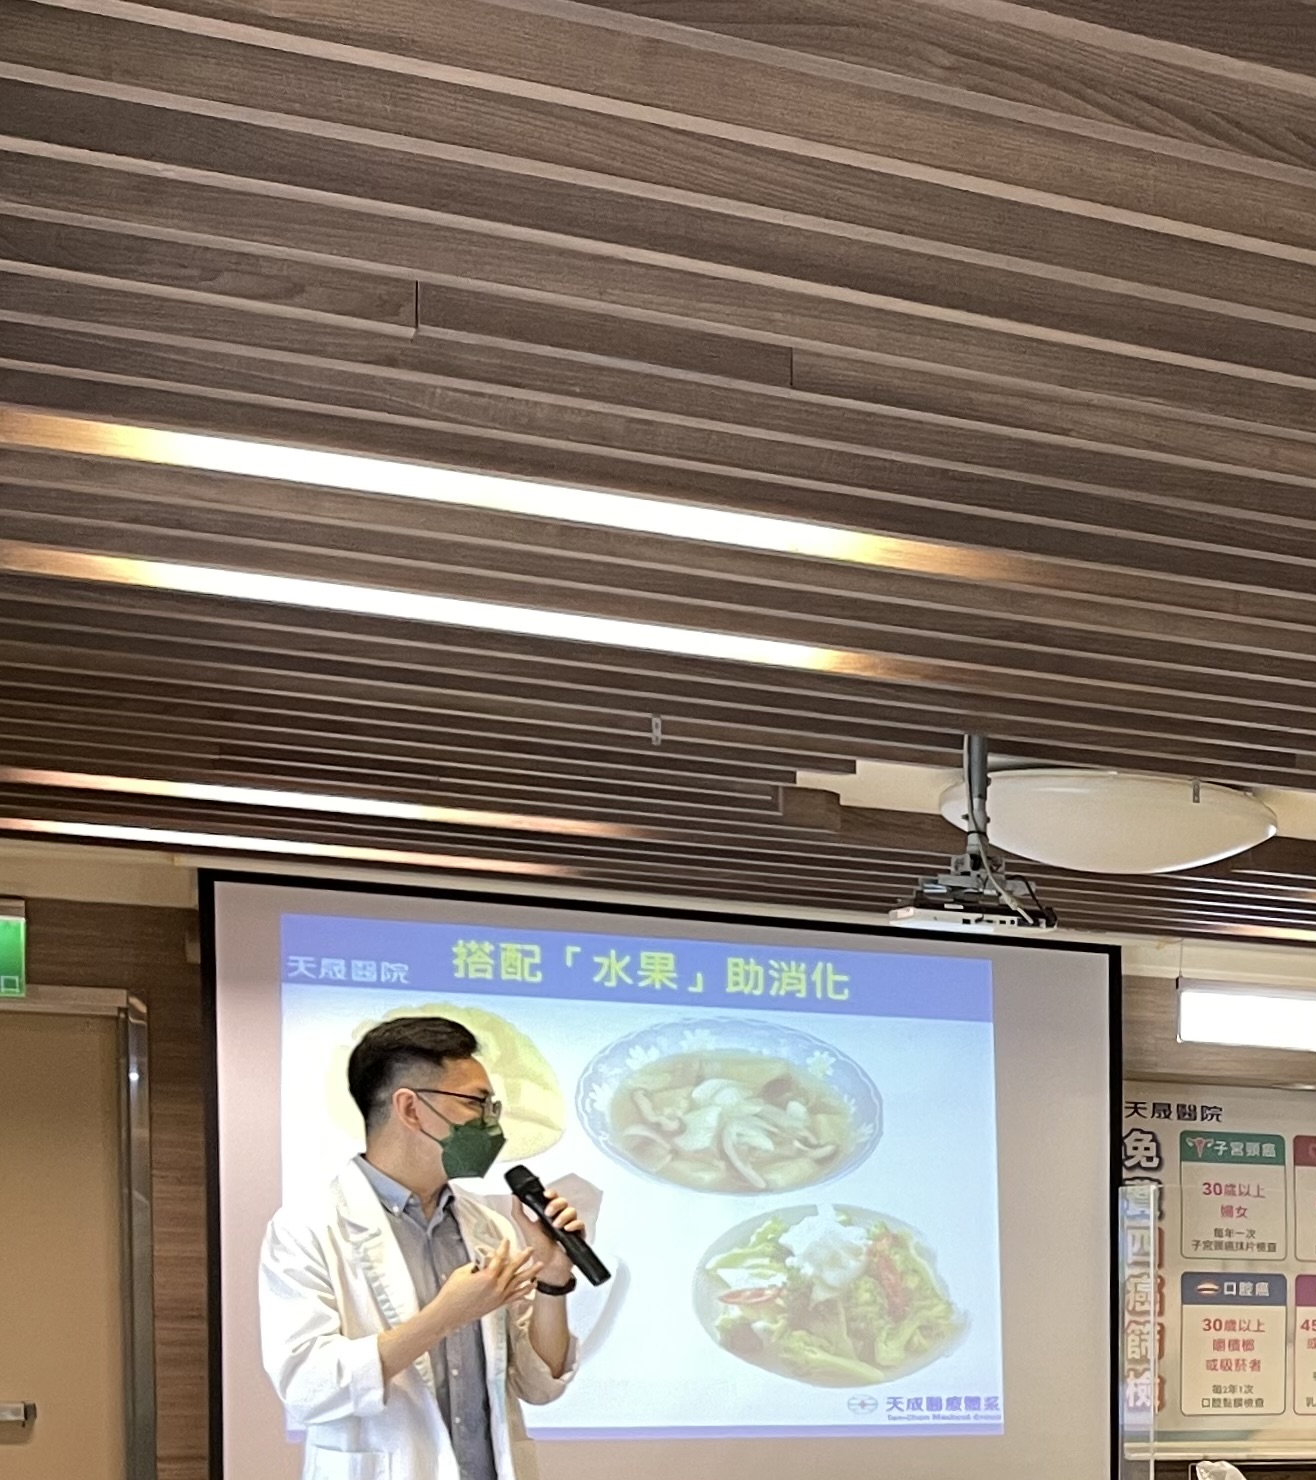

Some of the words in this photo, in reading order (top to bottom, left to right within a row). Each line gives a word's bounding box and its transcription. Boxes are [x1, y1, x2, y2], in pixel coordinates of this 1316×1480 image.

[452, 939, 850, 1000] 搭配「水果」助消化
[1124, 1101, 1223, 1122] 天晟醫院
[1213, 1141, 1277, 1158] 子宮頸癌
[1202, 1182, 1266, 1198] 30歲以上
[1220, 1205, 1248, 1219] 婦女
[1213, 1227, 1256, 1239] 每年一次
[1223, 1281, 1270, 1297] 口腔癌
[1202, 1317, 1266, 1333] 30歲以上
